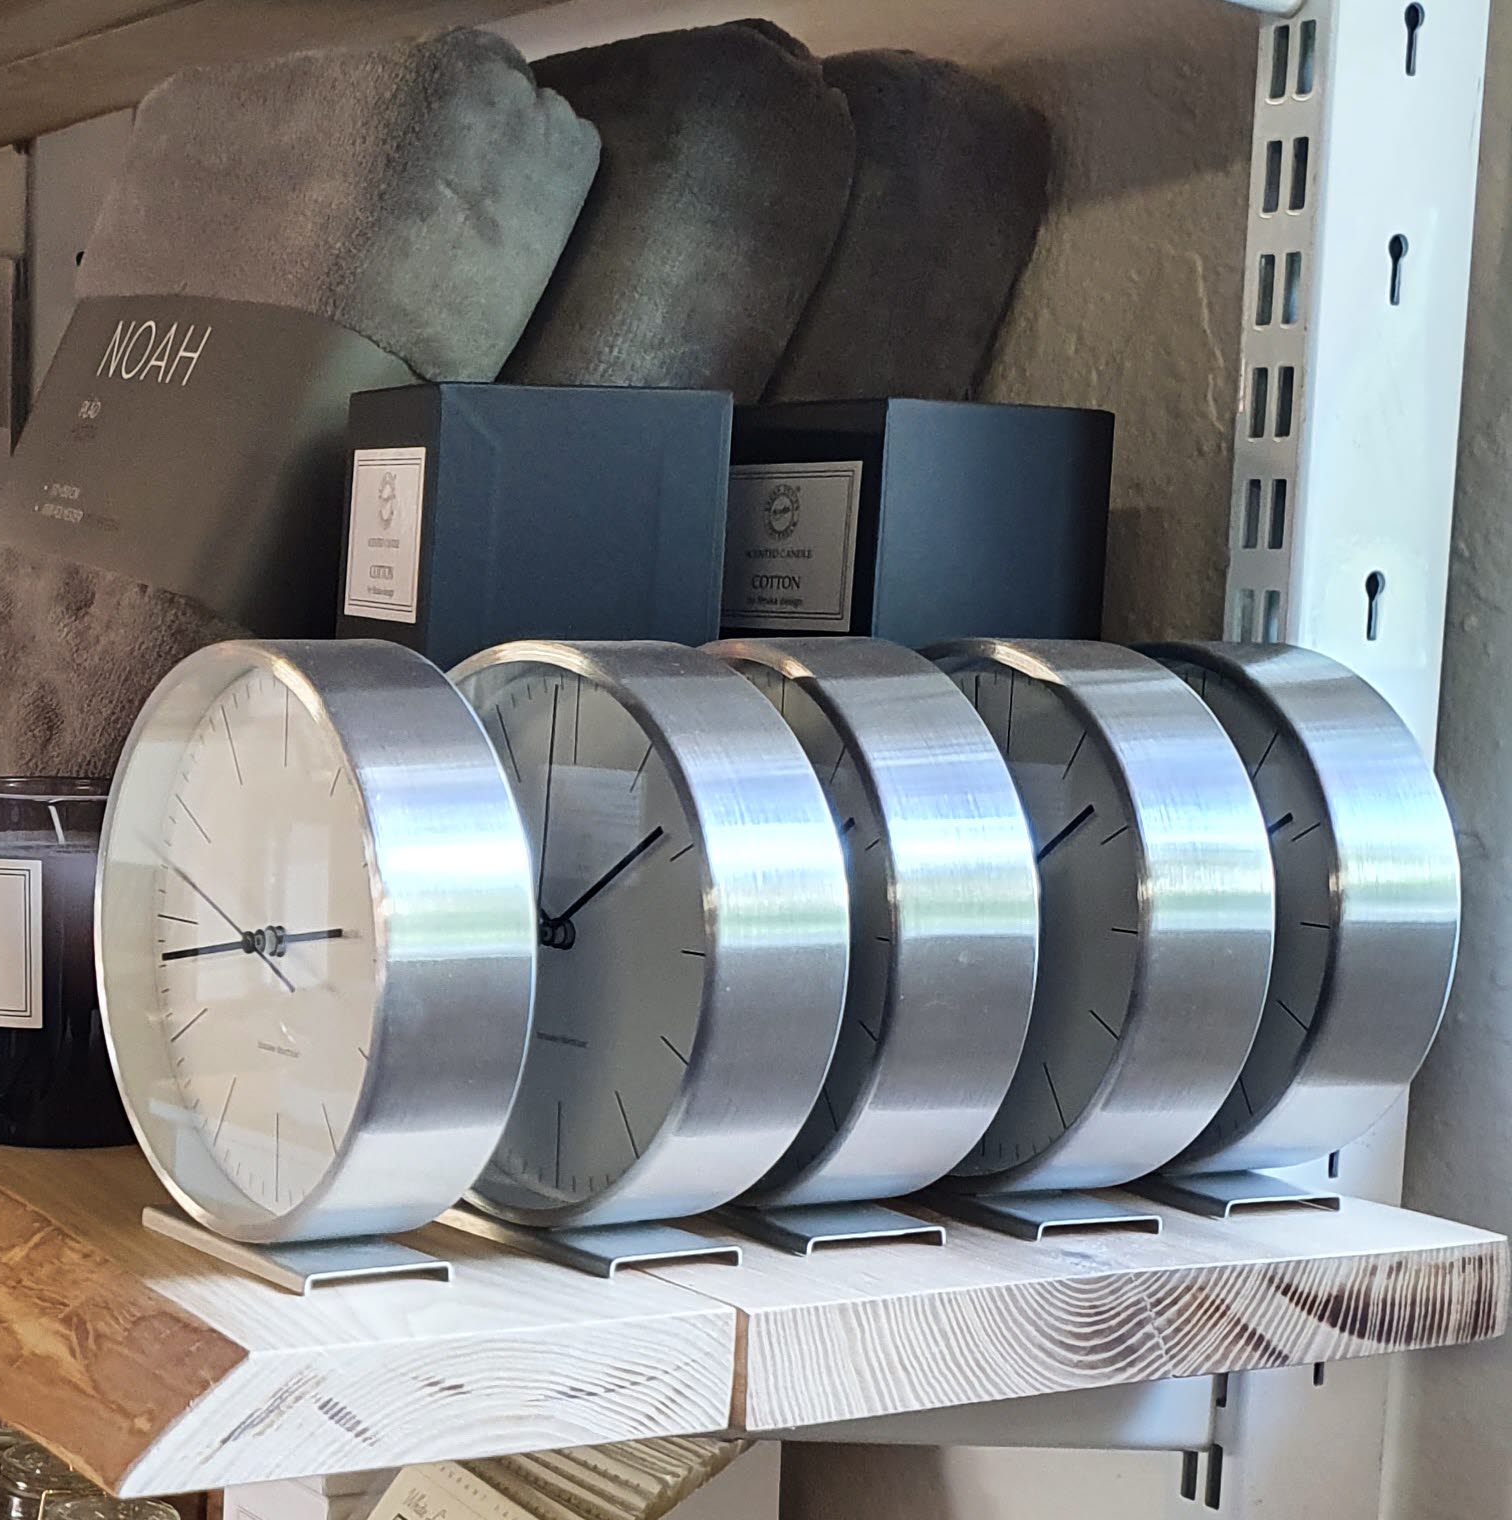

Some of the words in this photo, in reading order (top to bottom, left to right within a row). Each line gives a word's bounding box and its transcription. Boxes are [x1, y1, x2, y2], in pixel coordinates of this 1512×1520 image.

[96, 319, 212, 387] NOAH
[752, 574, 801, 590] COTTON
[403, 1487, 429, 1519] White
